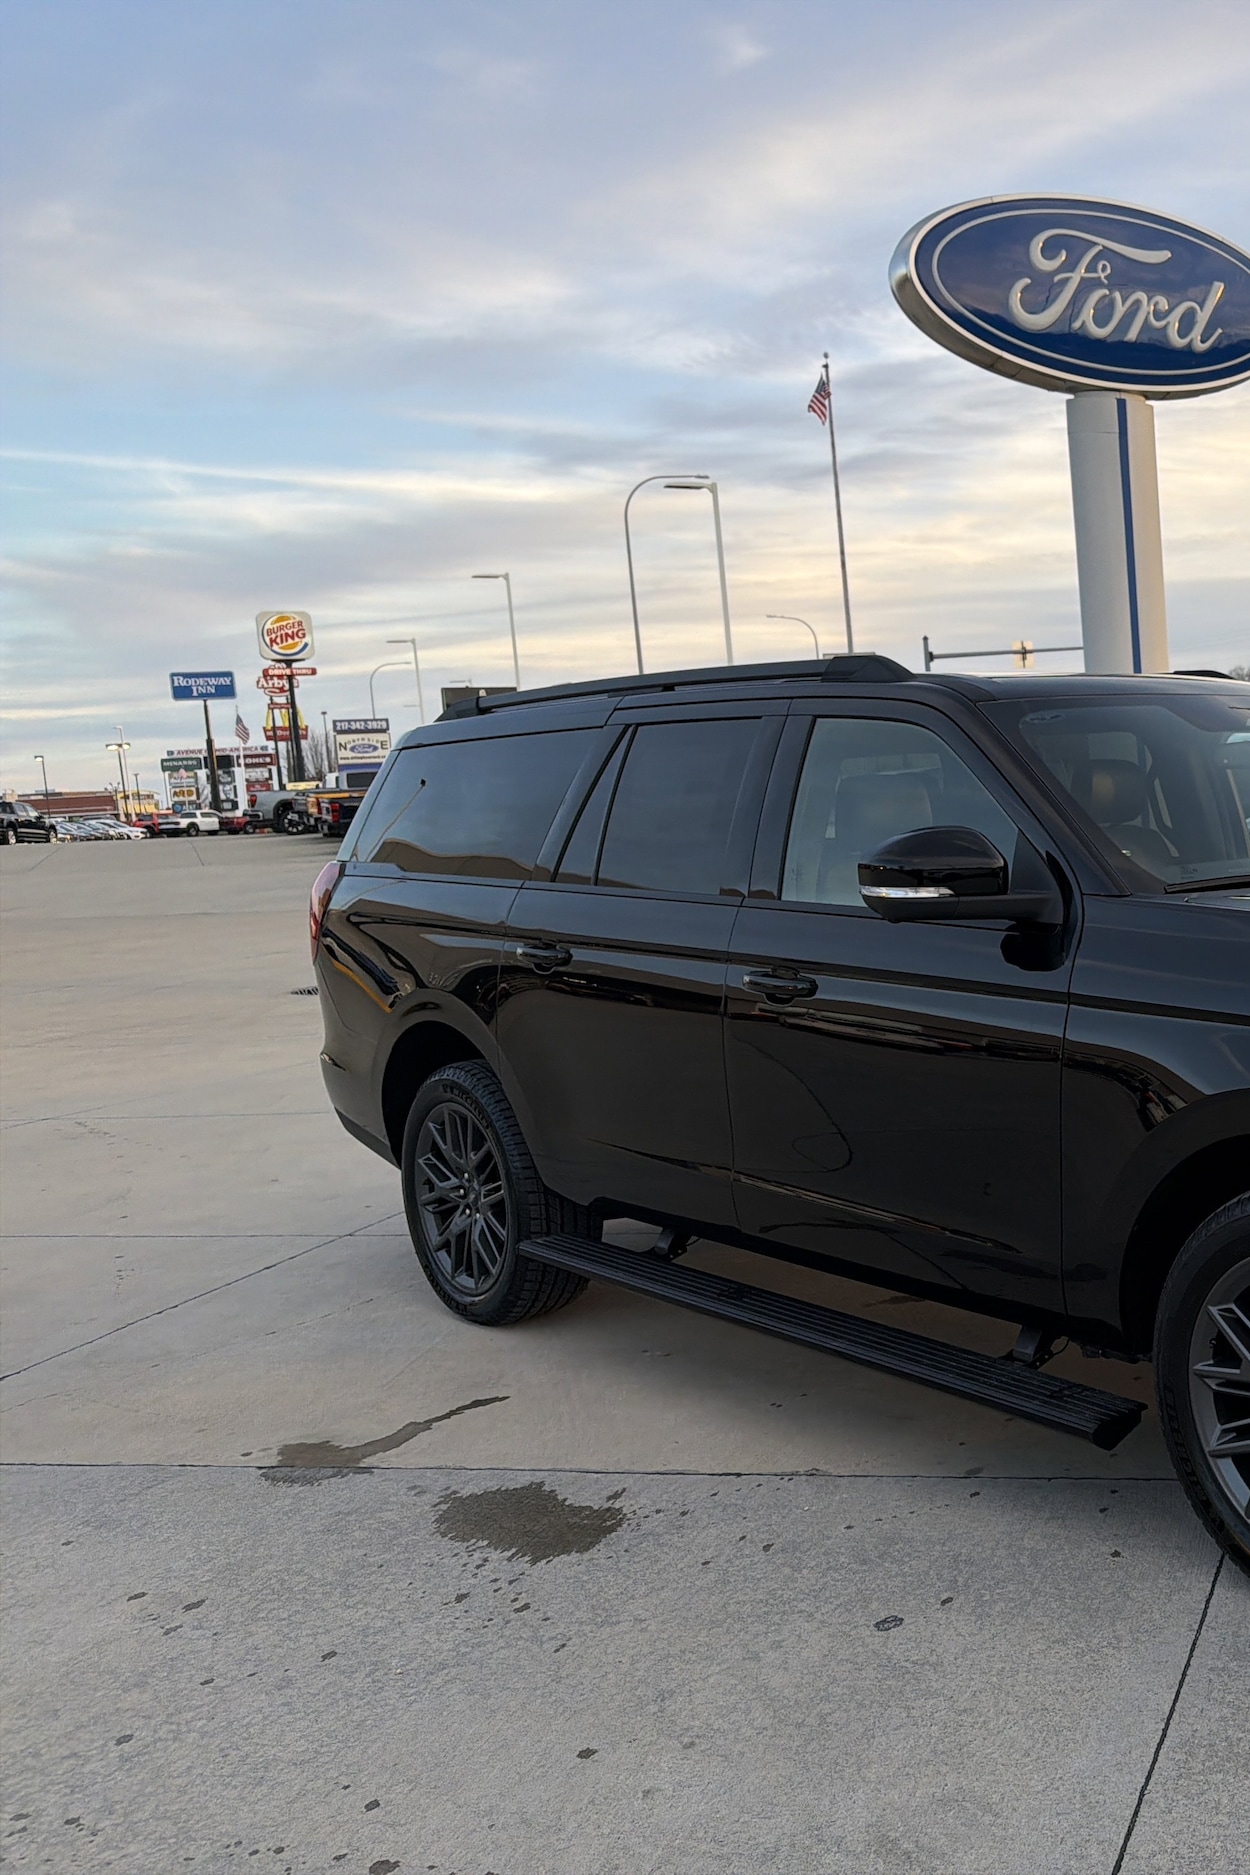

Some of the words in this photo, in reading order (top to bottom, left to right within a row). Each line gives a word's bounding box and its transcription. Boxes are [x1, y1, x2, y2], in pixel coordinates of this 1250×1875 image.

[1009, 227, 1226, 354] Ford
[266, 620, 304, 637] BURGER
[269, 628, 307, 648] KING
[268, 668, 292, 676] DRIVE
[293, 667, 312, 675] THRU
[172, 675, 232, 687] RODEWAY
[191, 685, 216, 697] INN
